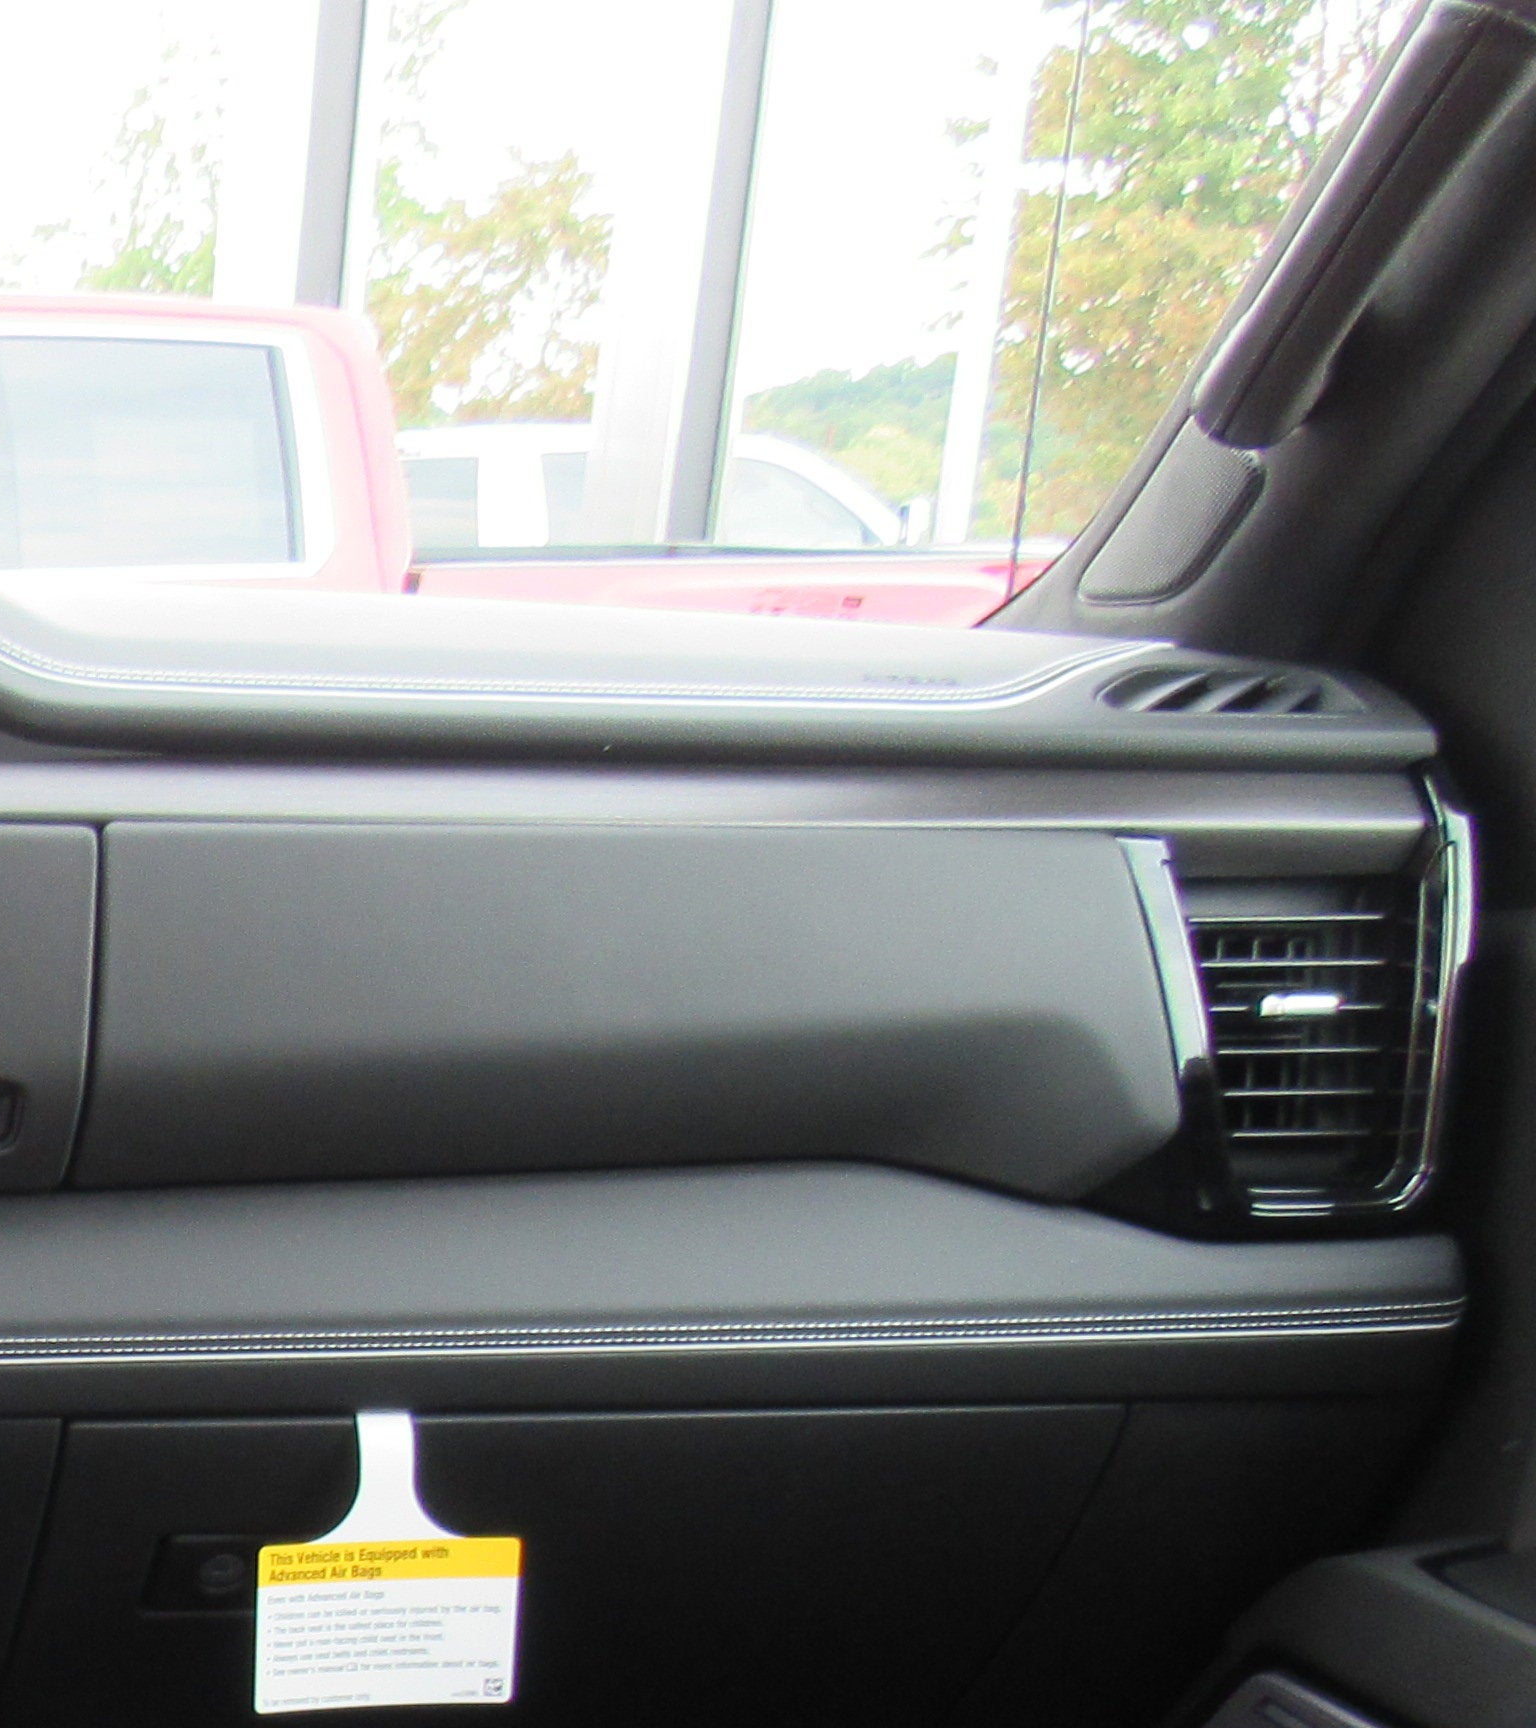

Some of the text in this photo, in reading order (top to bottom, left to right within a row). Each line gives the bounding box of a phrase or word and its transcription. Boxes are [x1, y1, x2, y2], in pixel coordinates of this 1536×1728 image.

[270, 1546, 449, 1566] This Vehicle is Equipped with
[269, 1564, 382, 1582] Advanced Air Bags
